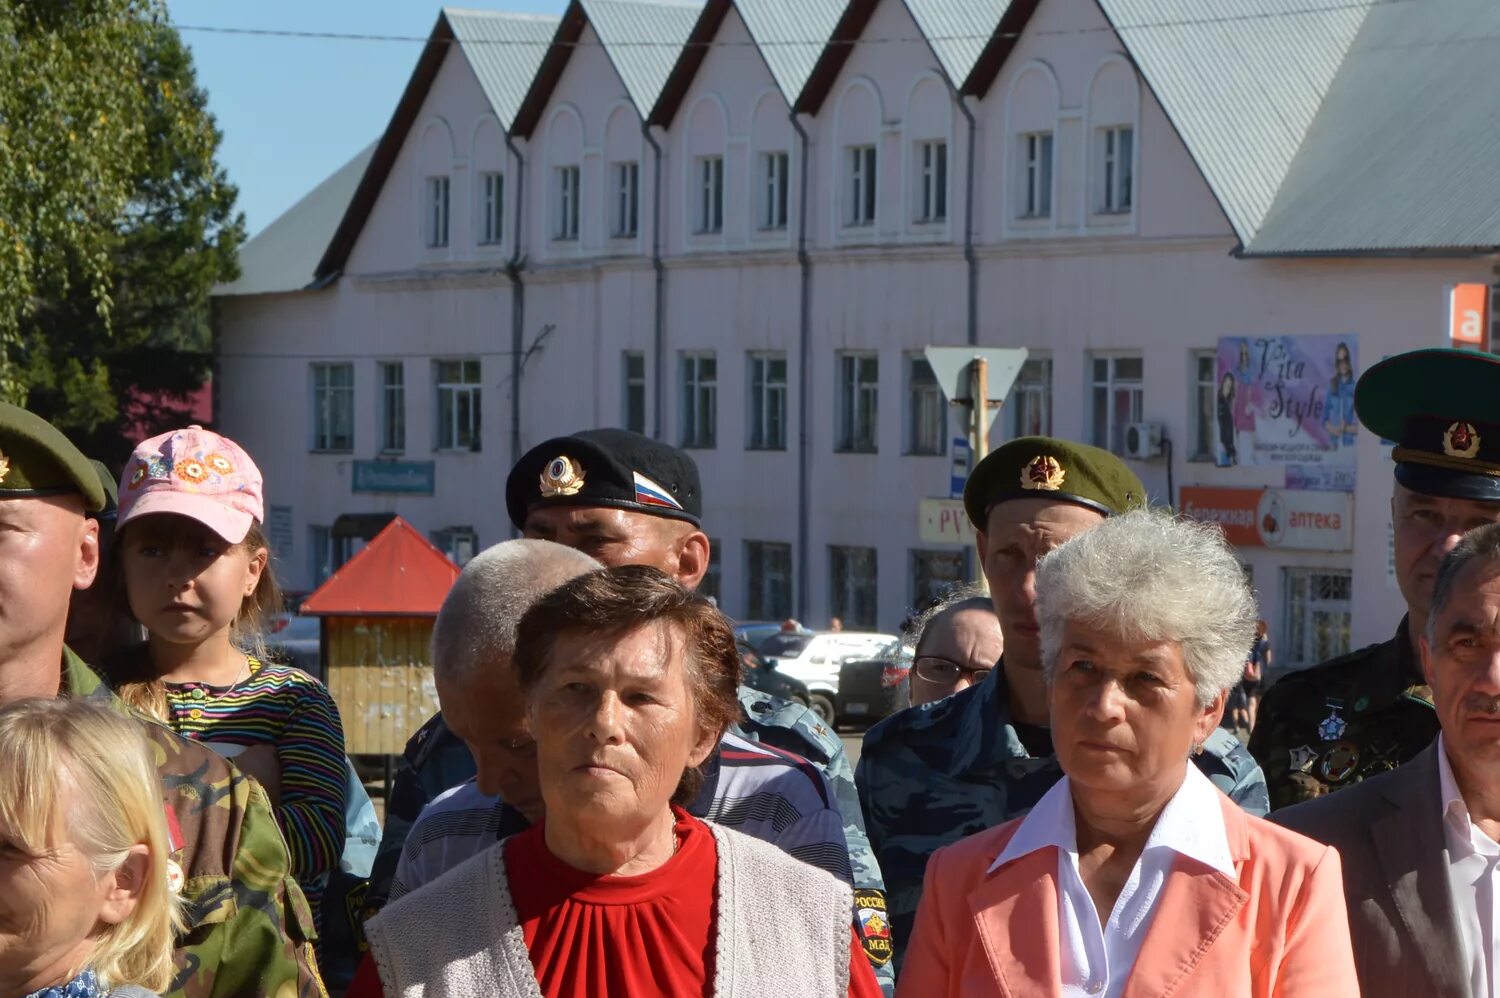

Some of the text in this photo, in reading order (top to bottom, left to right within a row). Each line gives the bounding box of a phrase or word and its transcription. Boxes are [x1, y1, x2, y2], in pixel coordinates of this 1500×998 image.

[1255, 337, 1307, 381] Vita
[1263, 379, 1324, 438] Style
[1288, 510, 1342, 532] аптека
